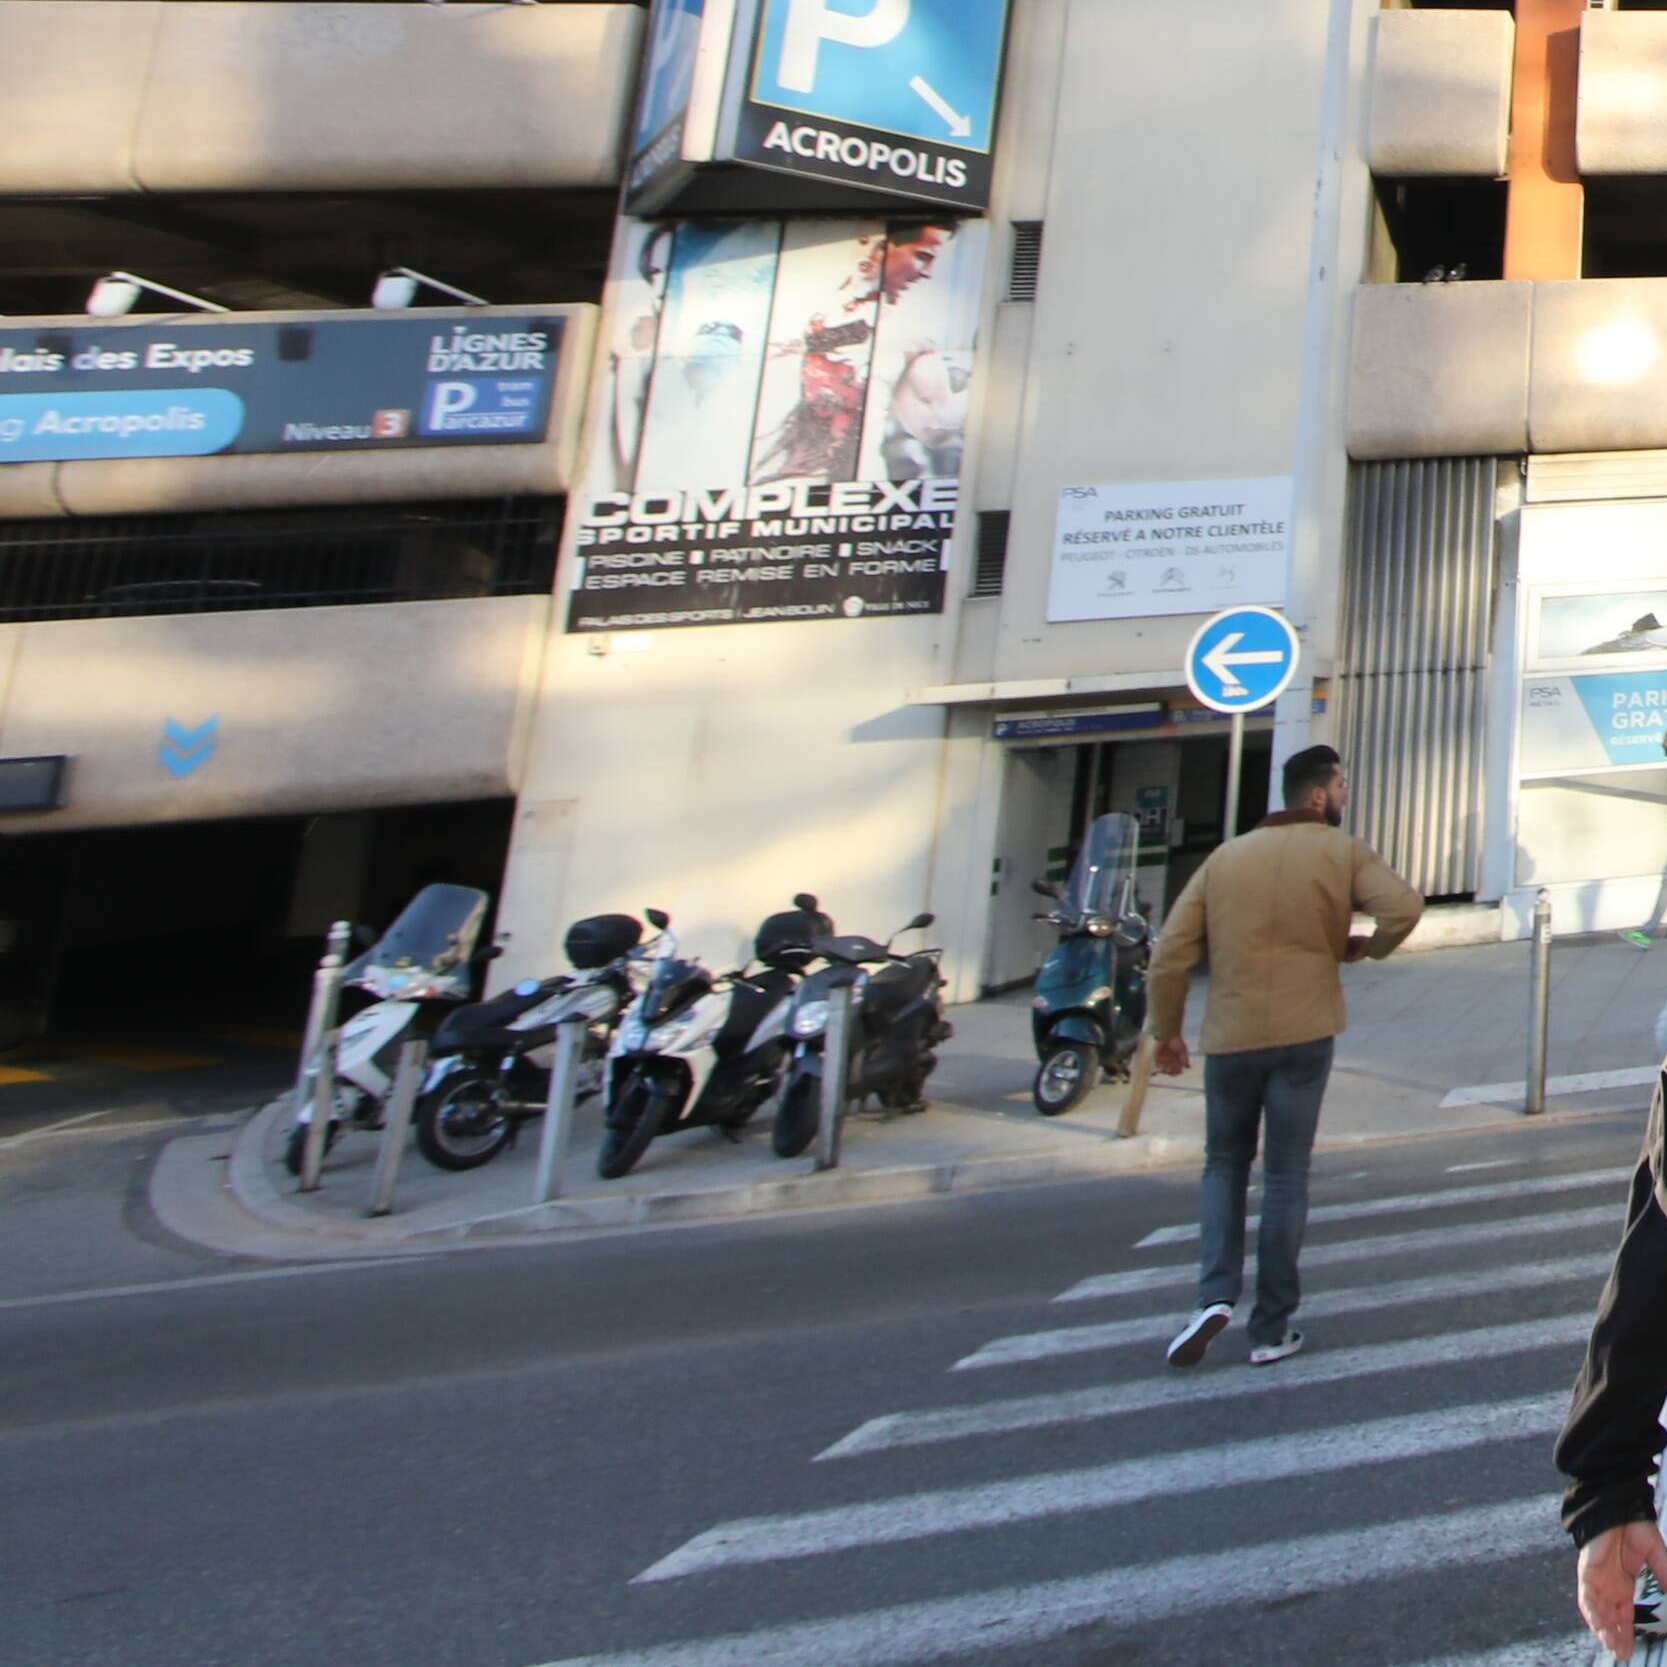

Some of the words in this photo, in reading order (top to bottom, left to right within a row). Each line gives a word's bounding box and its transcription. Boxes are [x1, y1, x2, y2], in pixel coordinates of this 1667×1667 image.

[763, 121, 967, 189] ACROPOLIS
[72, 345, 138, 371] des
[144, 343, 255, 373] Expos
[427, 351, 545, 372] D'AZUR
[32, 405, 206, 437] Acropolis
[283, 422, 373, 442] Niveau
[380, 412, 402, 436] 3
[582, 479, 959, 529] COMPLEXE
[1104, 507, 1174, 524] PARKING
[1178, 503, 1246, 519] GRATUIT
[576, 520, 742, 546] SPORTIF
[751, 511, 954, 539] MUNICIPAL
[1151, 525, 1203, 541] NOTRE
[1207, 520, 1285, 538] CLIENTÈLE
[589, 550, 685, 570] PISCINE
[710, 543, 831, 565] PATINOIRE
[856, 538, 937, 557] SNACK
[585, 571, 687, 592] ESPACE
[697, 565, 794, 586] REMISE
[803, 561, 840, 580] EN
[848, 558, 937, 577] FORME
